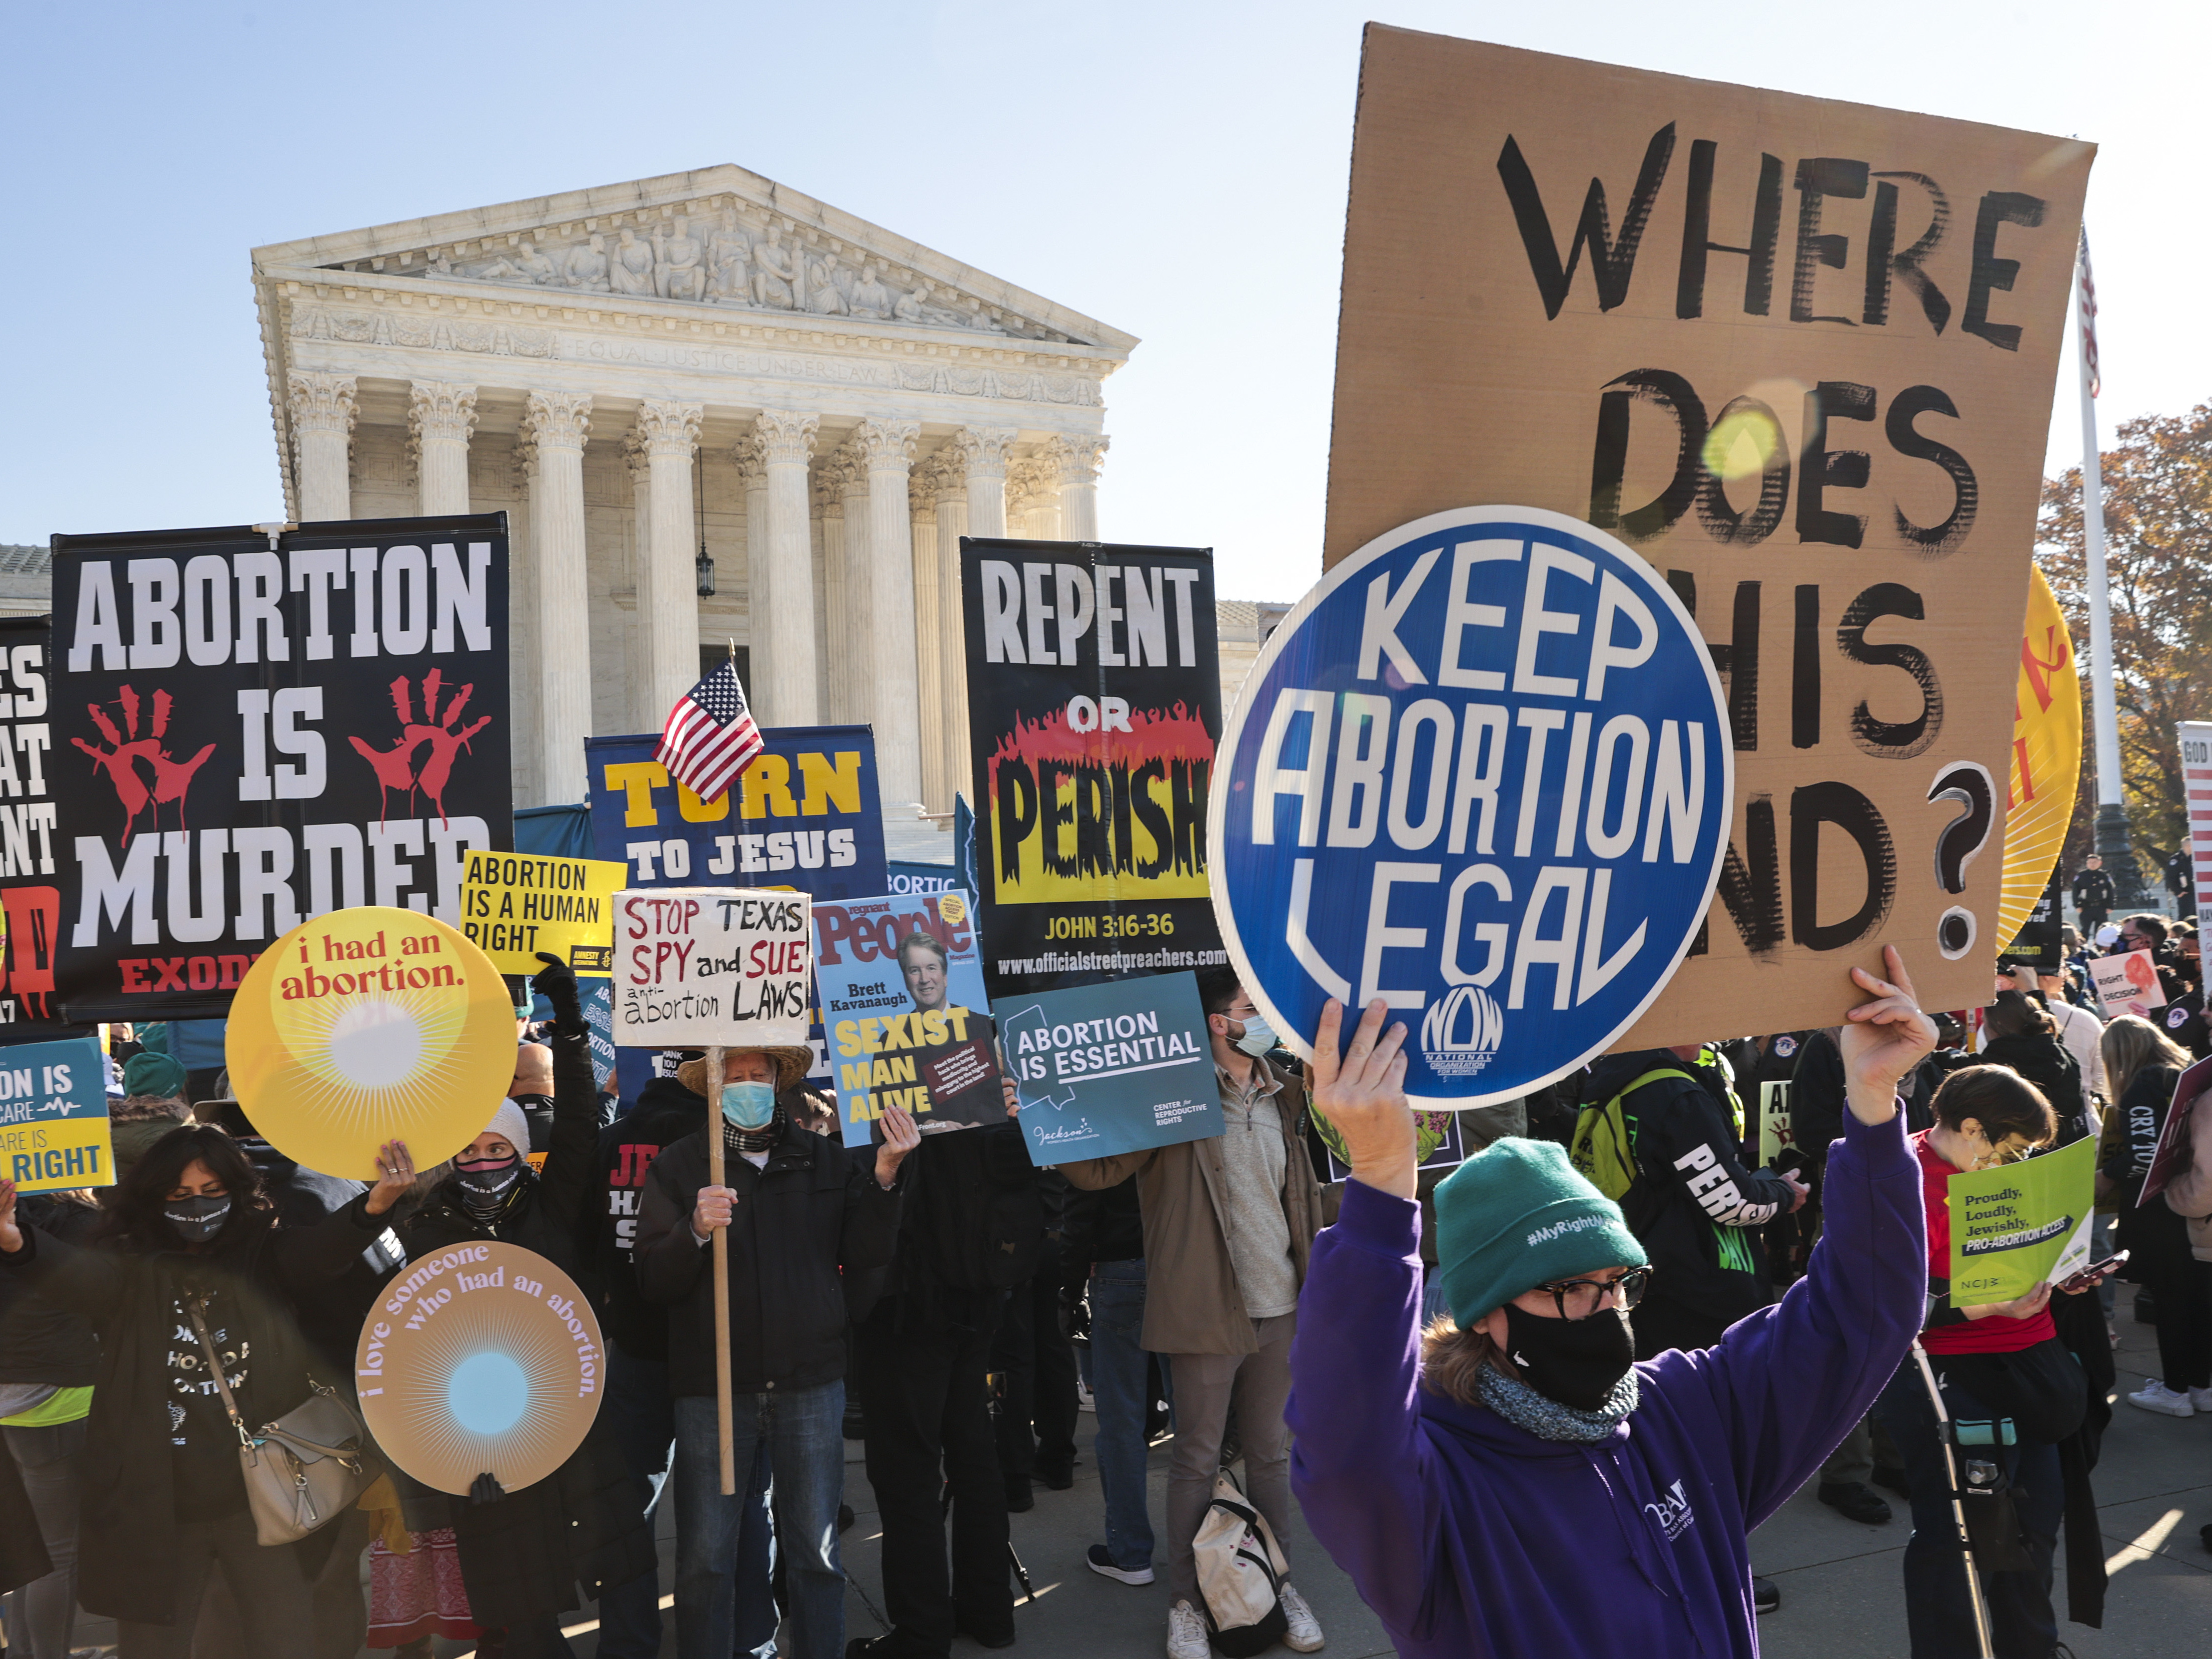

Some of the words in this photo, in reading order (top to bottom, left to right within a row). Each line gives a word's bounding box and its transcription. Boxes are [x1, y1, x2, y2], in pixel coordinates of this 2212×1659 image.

[1497, 120, 2051, 351] WHERE
[575, 340, 653, 362] EQUAL
[660, 349, 746, 371] JUSTICE
[757, 357, 830, 378] UNDER
[838, 364, 877, 381] LAW
[1589, 367, 1979, 559] DOES
[69, 542, 491, 672] ABORTION
[980, 560, 1199, 667] REPENT
[1357, 538, 1658, 701] KEEP
[1652, 565, 1943, 759] HIS
[1067, 695, 1133, 733] OR
[237, 686, 327, 801] IS
[2184, 740, 2208, 763] GOD
[604, 751, 861, 828] TURN
[1251, 688, 1706, 864] ABORTION
[996, 757, 1208, 887] PERISH
[626, 838, 691, 881] TO
[708, 828, 857, 875] JESUS
[467, 856, 586, 891] ABORTION
[467, 890, 490, 917] IS
[499, 892, 514, 919] A
[523, 894, 600, 924] HUMAN
[625, 897, 700, 939] STOP
[717, 900, 803, 932] TEXAS
[465, 922, 539, 952] RIGHT
[1045, 916, 1096, 939] JOHN
[1102, 913, 1174, 937] 3:16-36
[1286, 858, 1648, 1009] LEGAL
[299, 936, 309, 963] i
[322, 930, 386, 962] had
[401, 934, 441, 956] an
[573, 950, 600, 960] AMNESTY
[630, 938, 695, 985] SPY
[697, 946, 741, 977] and
[746, 940, 807, 978] SUE
[998, 948, 1228, 975] www.officialstreetpreachers.com
[281, 958, 464, 1001] abortion.
[627, 985, 664, 1000] anti-
[847, 982, 887, 999] Brett
[2098, 974, 2123, 986] RIGHT
[2105, 987, 2142, 1002] DECISION
[624, 990, 719, 1025] abortion
[830, 993, 908, 1012] Kavanaugh
[1421, 986, 1504, 1052] NOW
[835, 1006, 969, 1057] SEXIST
[1018, 1011, 1159, 1054] ABORTION
[840, 1055, 918, 1091] MAN
[934, 1060, 947, 1069] Meet
[955, 1046, 975, 1059] political
[938, 1067, 950, 1075] hack
[960, 1054, 976, 1064] brings
[942, 1066, 968, 1081] mediocrity
[1020, 1055, 1047, 1081] IS
[1054, 1031, 1201, 1075] ESSENTIAL
[43, 1064, 73, 1095] IS
[935, 1079, 958, 1093] misogyny
[971, 1062, 990, 1074] highest
[947, 1085, 960, 1095] court
[849, 1085, 933, 1123] ALIVE
[1154, 1101, 1182, 1112] CENTER
[1155, 1103, 1208, 1119] REPRODUCTIVE
[1156, 1116, 1182, 1126] RIGHTS
[32, 1129, 48, 1148] IS
[1033, 1126, 1093, 1146] Jackson
[2129, 1106, 2157, 1138] CRY
[13, 1145, 101, 1183] RIGHT
[1965, 1188, 2022, 1206] Proudly,
[1966, 1205, 2016, 1221] Loudly,
[1966, 1218, 2029, 1237] Jewishly,
[1966, 1229, 2040, 1251] PRO-ABORTION
[2041, 1216, 2066, 1238] ACCESS
[386, 1245, 490, 1316] someone
[358, 1321, 391, 1377] love
[405, 1288, 452, 1331] who
[456, 1266, 505, 1294] had
[513, 1275, 543, 1298] an
[547, 1293, 600, 1398] abortion.
[358, 1387, 384, 1398] i
